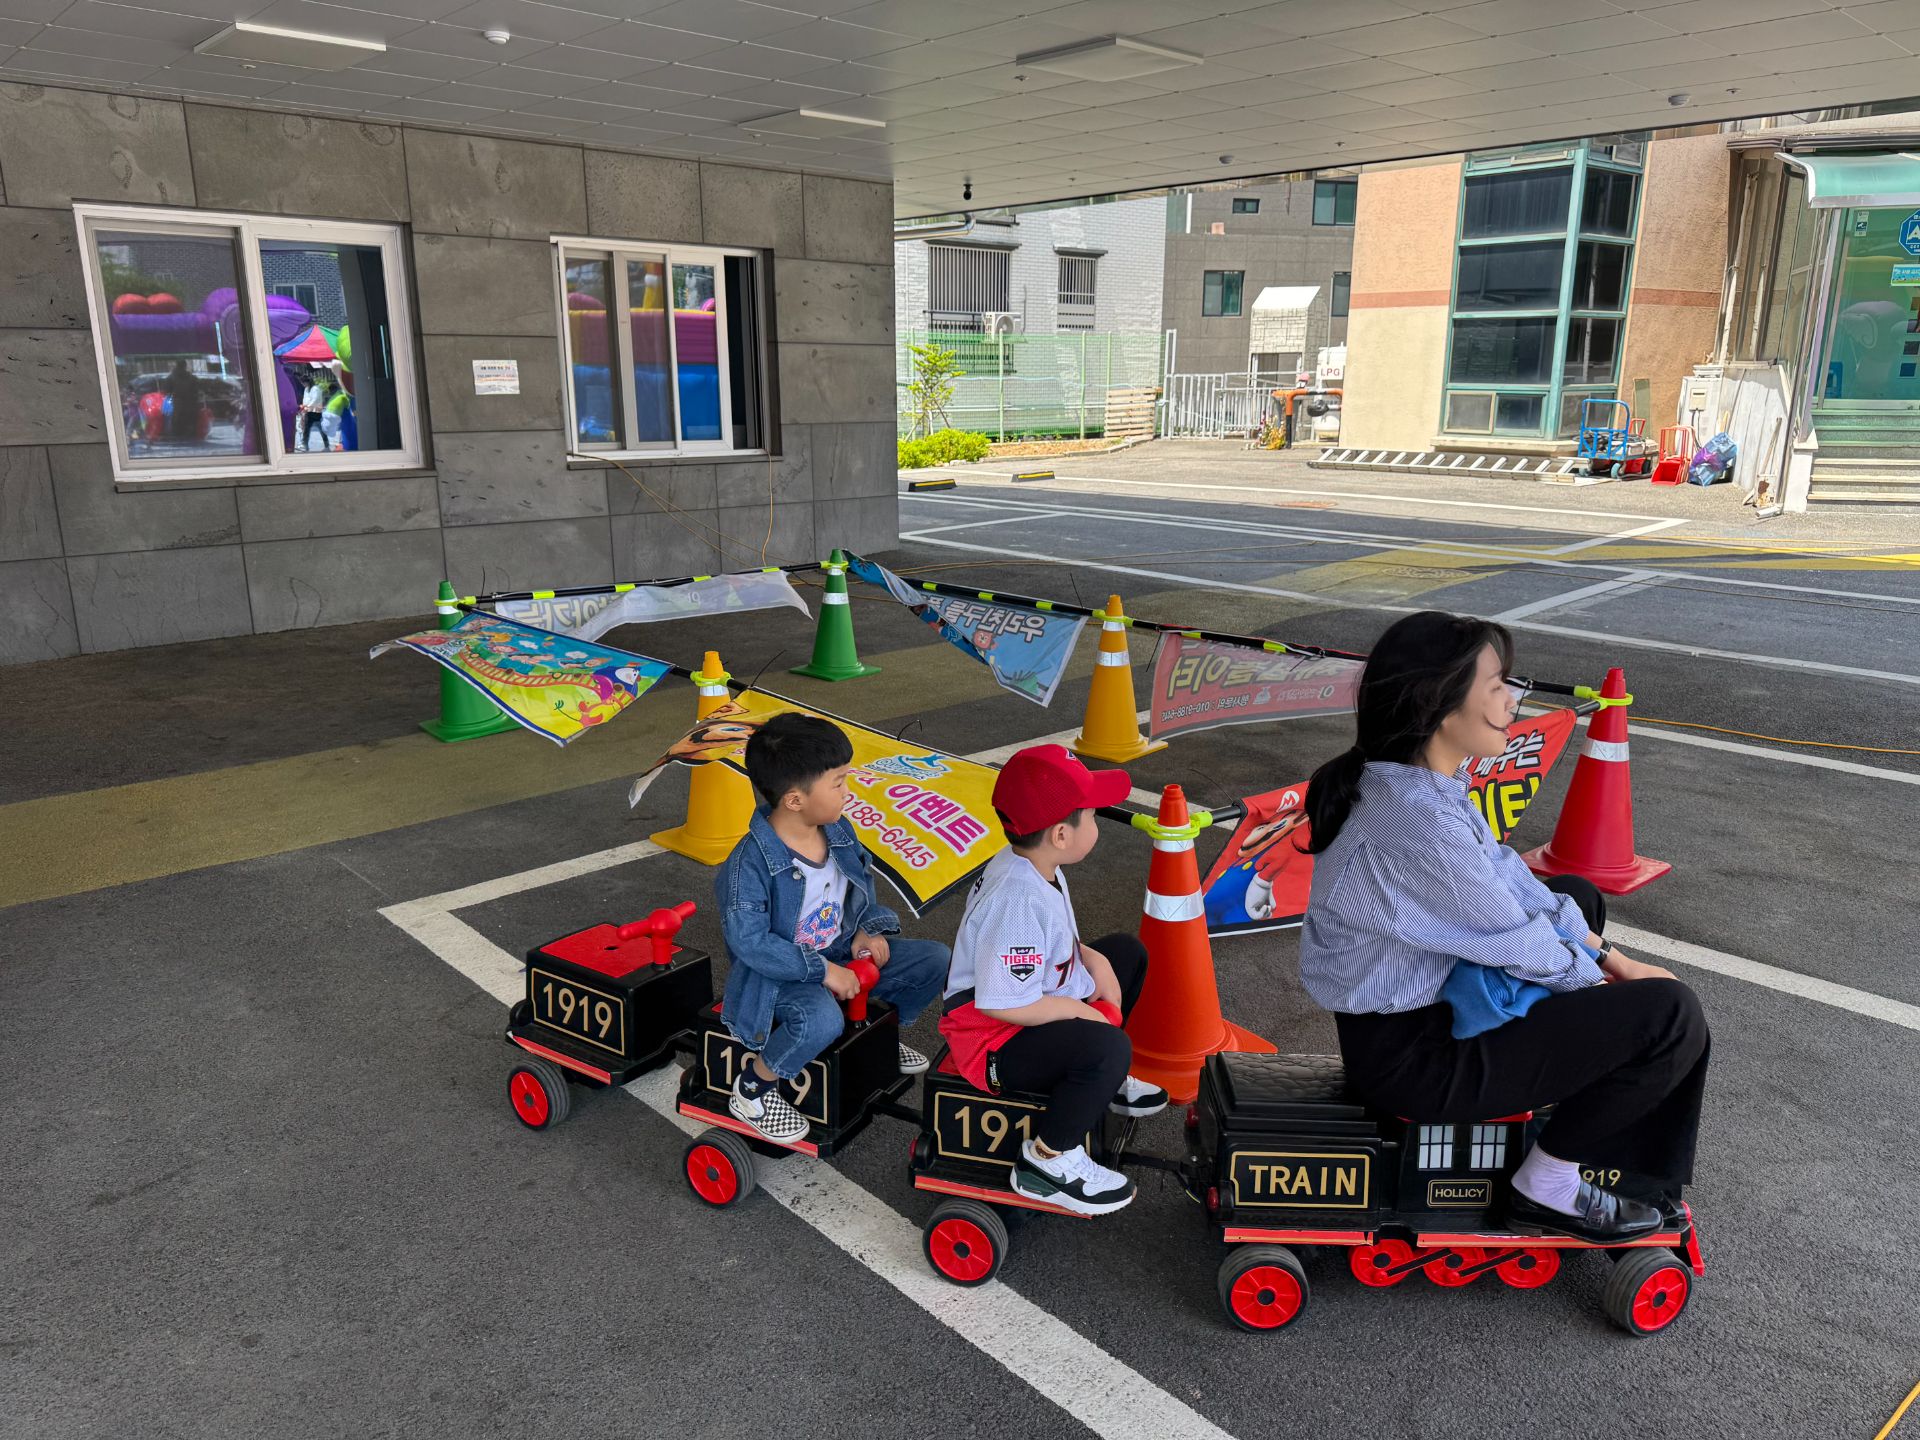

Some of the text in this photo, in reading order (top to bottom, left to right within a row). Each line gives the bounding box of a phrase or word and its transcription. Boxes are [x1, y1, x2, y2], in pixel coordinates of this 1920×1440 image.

[1320, 367, 1340, 377] LPG
[888, 784, 986, 853] 이벤트
[1000, 953, 1044, 966] TIGERS
[543, 982, 613, 1039] 1919
[954, 1105, 1032, 1153] 191
[1248, 1164, 1357, 1196] TRAIN
[1582, 1169, 1621, 1187] 919
[1434, 1188, 1485, 1199] HOLLICY
